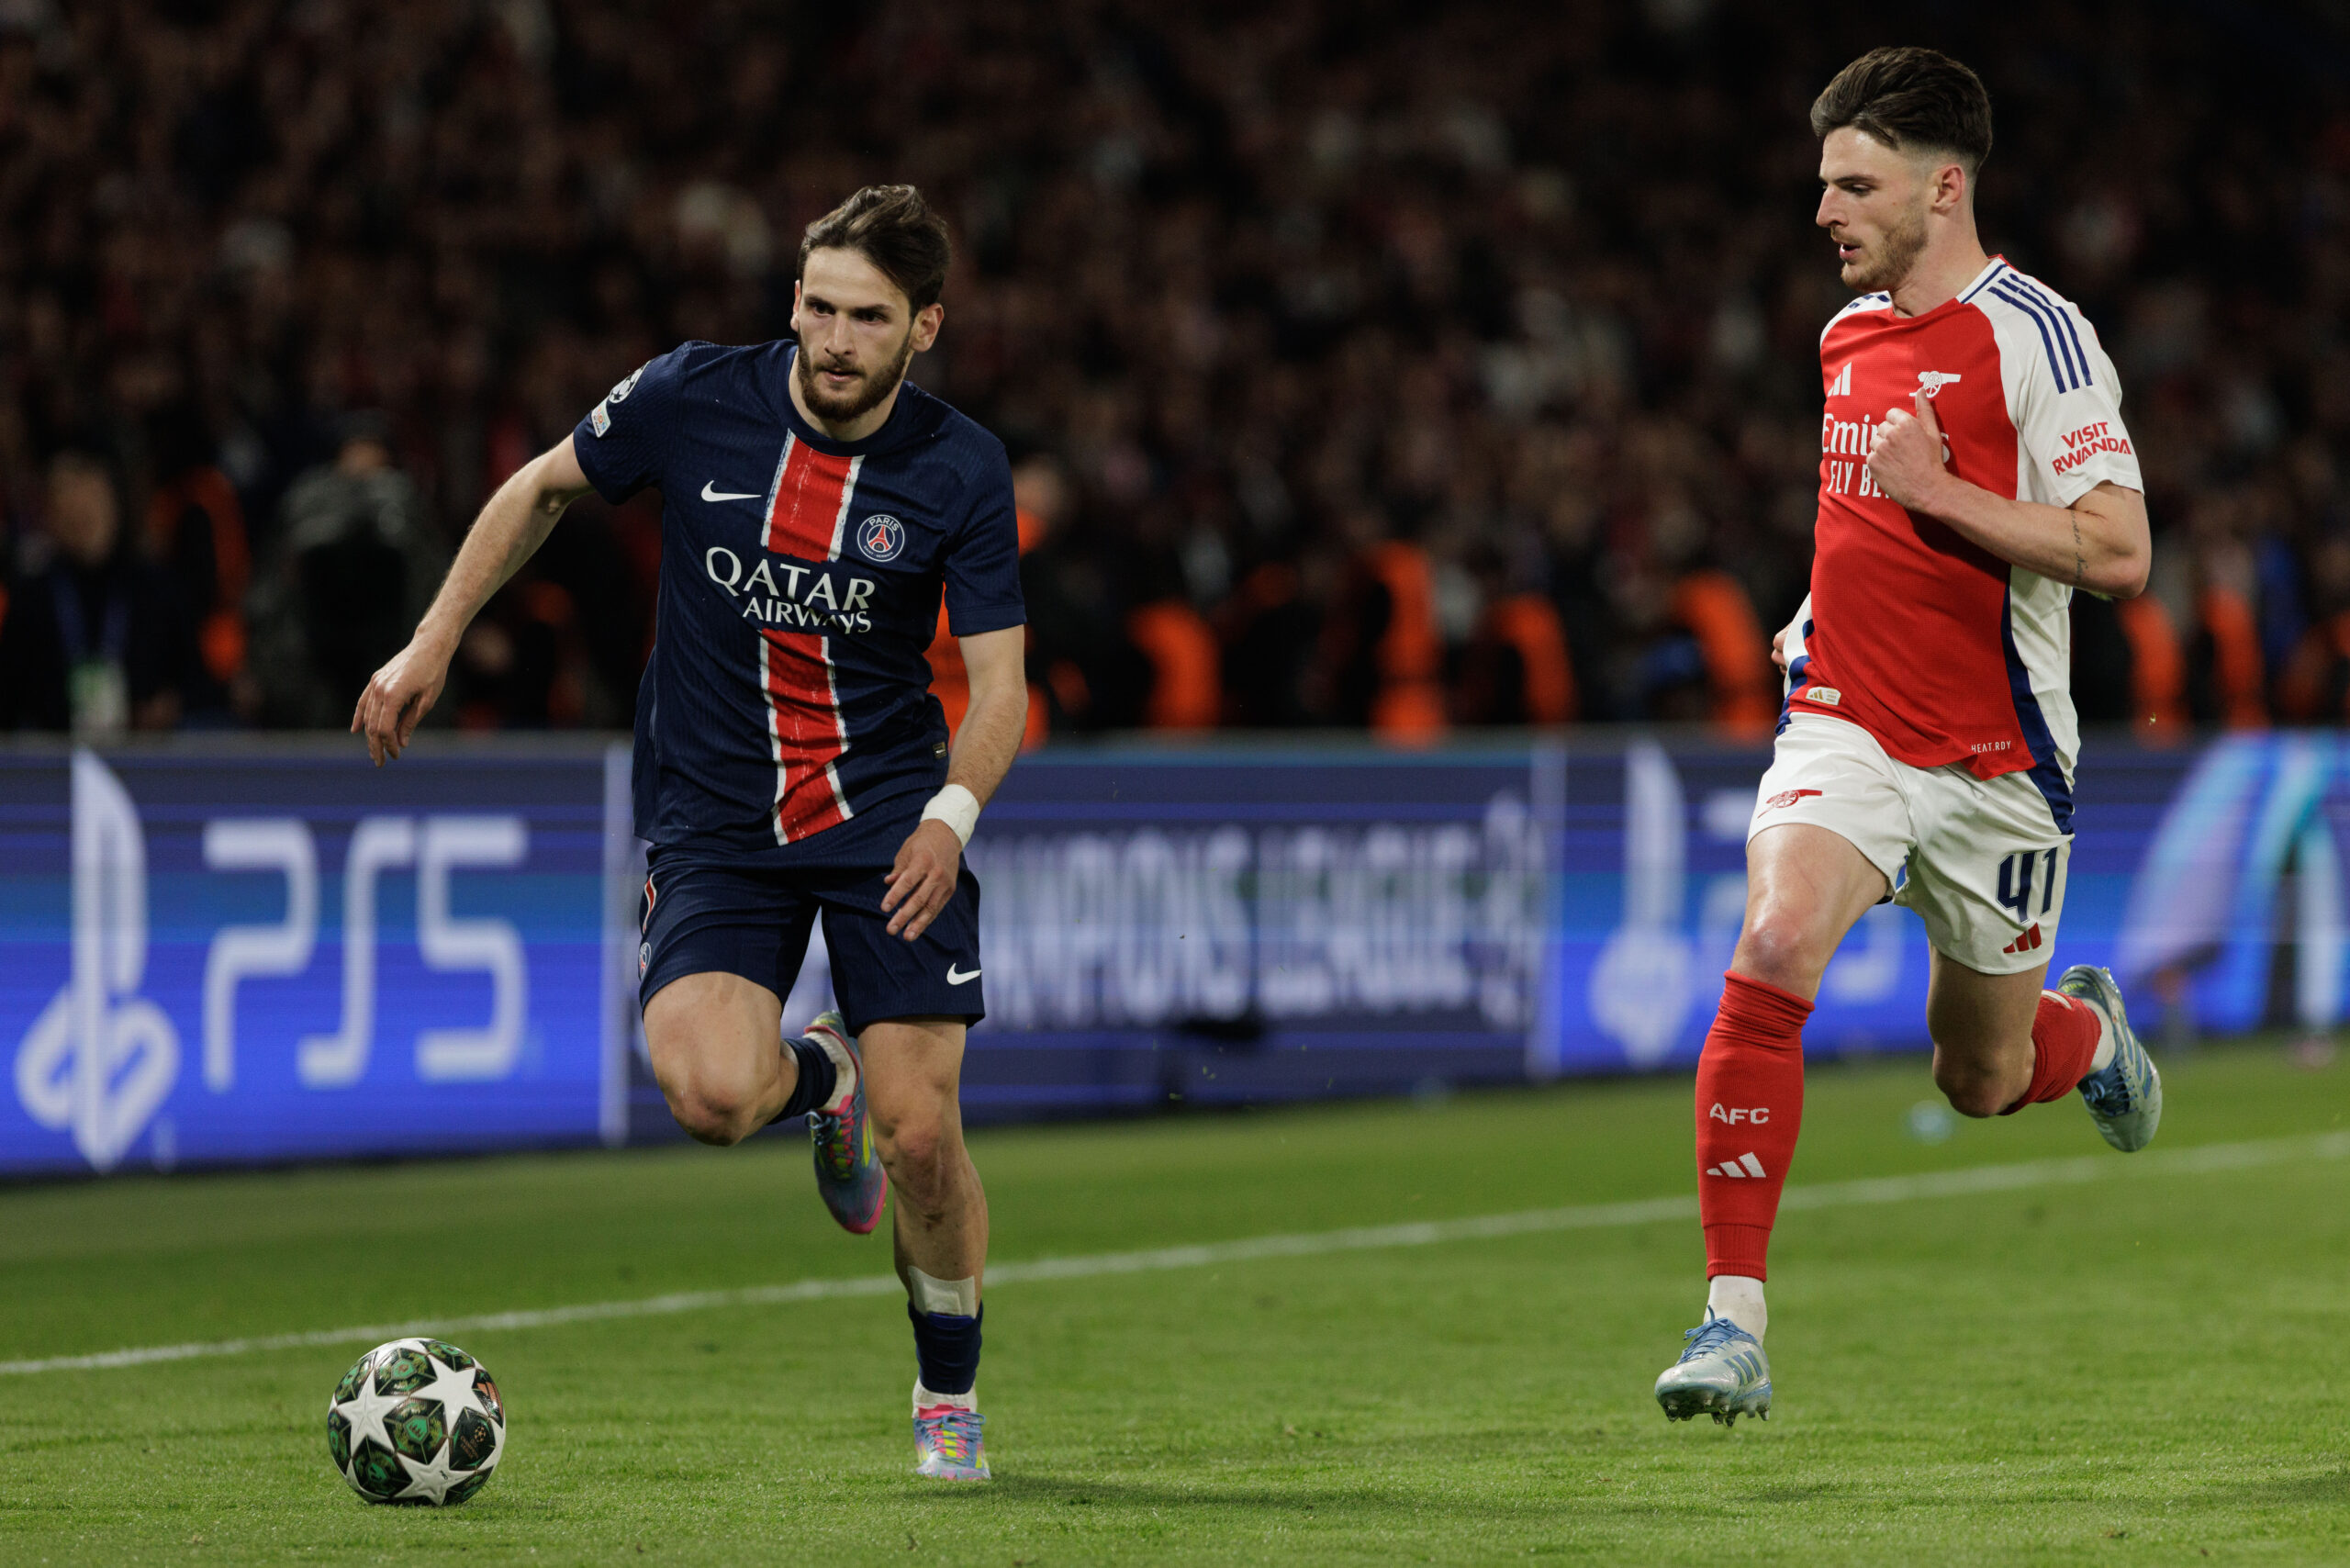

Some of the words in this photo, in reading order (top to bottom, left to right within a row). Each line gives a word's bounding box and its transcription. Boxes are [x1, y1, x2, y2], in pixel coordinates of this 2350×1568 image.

[2061, 421, 2109, 449] VISIT
[2052, 438, 2132, 476] RWANDA
[1826, 460, 1854, 495] FLY
[868, 517, 900, 532] PARIS
[706, 546, 876, 611] QATAR
[742, 597, 872, 634] AIRWAYS
[1971, 740, 2011, 753] HEAT.RDY
[1996, 846, 2059, 925] 41
[202, 817, 530, 1092] PS5
[1709, 1103, 1770, 1126] AFC
